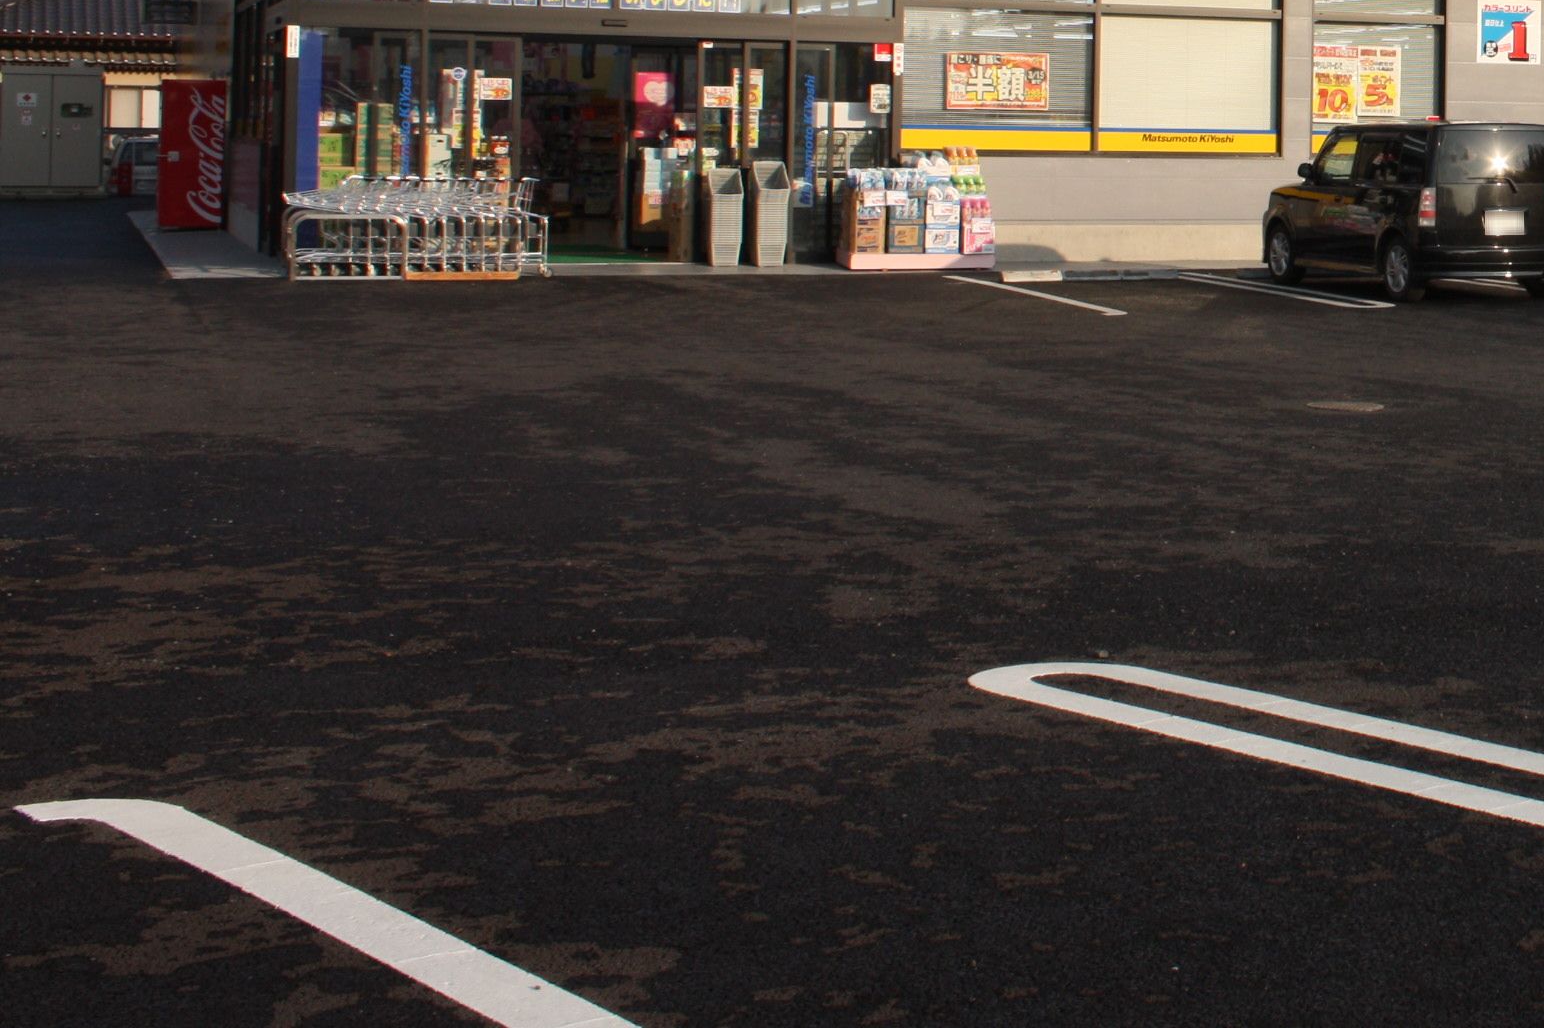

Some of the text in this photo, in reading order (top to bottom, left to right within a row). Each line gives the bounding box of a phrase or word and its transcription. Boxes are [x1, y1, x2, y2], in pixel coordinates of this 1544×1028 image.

[1508, 21, 1529, 61] 1
[966, 65, 1025, 101] 半額
[1141, 133, 1234, 143] Matsumoto KiYoshi
